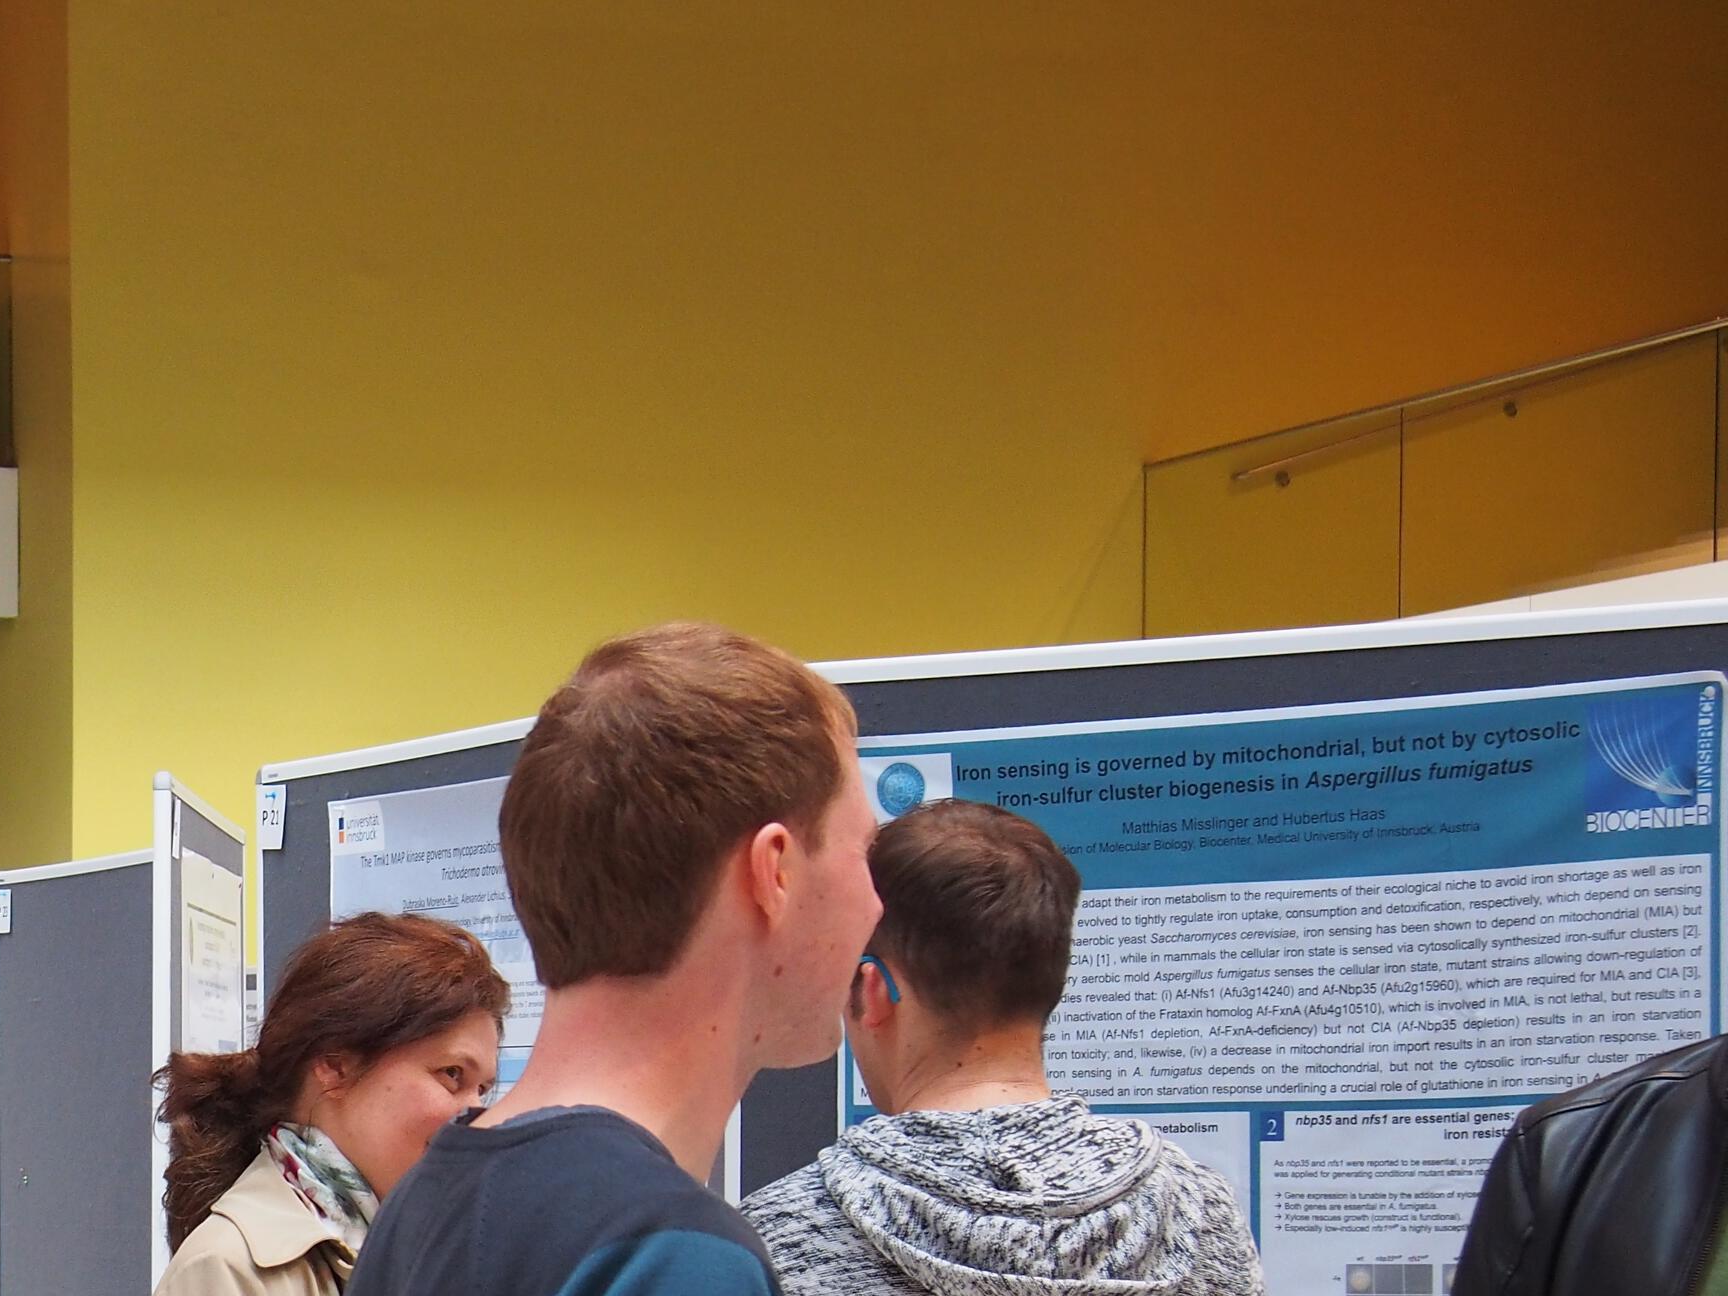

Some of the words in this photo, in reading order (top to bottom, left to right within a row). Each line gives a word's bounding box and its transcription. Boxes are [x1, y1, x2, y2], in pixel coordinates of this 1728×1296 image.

[956, 765, 991, 781] Iron
[994, 760, 1069, 779] sensing
[1075, 757, 1092, 773] is
[1095, 751, 1186, 776] governed
[1192, 749, 1216, 770] by
[1222, 739, 1365, 763] mitochondrial,
[1372, 736, 1406, 753] but
[1412, 733, 1445, 750] not
[1451, 730, 1476, 751] by
[1483, 721, 1580, 748] cytosolic
[994, 786, 1095, 810] iron-sulfur
[1098, 784, 1164, 801] cluster
[1168, 776, 1275, 799] biogenesis
[1281, 773, 1298, 790] in
[1304, 766, 1422, 789] Aspergillus
[1428, 759, 1533, 780] fumigatus
[262, 811, 269, 825] P
[270, 809, 279, 825] 21
[1122, 820, 1179, 836] Matthias
[1180, 816, 1251, 832] Misslinger
[1250, 813, 1278, 830] and
[1282, 811, 1346, 825] Hubertus
[1349, 808, 1386, 822] Haas
[1586, 804, 1710, 833] BIOCENTER
[1099, 841, 1151, 853] Molecular
[1082, 896, 1110, 908] adapt
[1114, 895, 1138, 906] their
[1140, 895, 1161, 905] iron
[1164, 892, 1227, 904] metabolism
[1229, 891, 1241, 901] to
[1243, 890, 1261, 900] the
[1264, 888, 1338, 901] requirements
[1340, 885, 1352, 896] of
[1354, 884, 1381, 895] their
[1383, 881, 1442, 895] ecological
[1444, 879, 1477, 890] niche
[1479, 879, 1492, 888] to
[1494, 874, 1528, 887] avoid
[1530, 873, 1554, 884] iron
[1557, 870, 1610, 882] shortage
[1612, 869, 1628, 878] as
[1630, 865, 1656, 877] well
[1659, 866, 1675, 875] as
[1678, 863, 1702, 874] iron
[1076, 915, 1118, 927] evolved
[1120, 915, 1133, 926] to
[1134, 913, 1167, 927] tightly
[1169, 911, 1214, 925] regulate
[1216, 910, 1238, 920] iron
[1240, 909, 1282, 921] uptake,
[1284, 905, 1357, 918] consumption
[1360, 903, 1384, 915] and
[1385, 900, 1465, 913] detoxification,
[1468, 894, 1542, 910] respectively,
[1546, 891, 1580, 902] which
[1583, 887, 1630, 901] depend
[1632, 888, 1650, 897] on
[1653, 884, 1702, 897] sensing
[1117, 934, 1147, 947] yeast
[1149, 931, 1237, 943] Saccharomyces
[1239, 928, 1299, 939] cerevisiae,
[1303, 927, 1324, 937] iron
[1328, 924, 1372, 937] sensing
[1375, 924, 1397, 934] has
[1400, 922, 1430, 933] been
[1433, 920, 1472, 931] shown
[1475, 919, 1488, 929] to
[1490, 914, 1536, 929] depend
[1538, 915, 1554, 924] on
[1558, 908, 1639, 922] mitochondrial
[1644, 905, 1679, 919] (MIA)
[1682, 904, 1702, 916] but
[1267, 1119, 1278, 1136] 2
[1295, 1115, 1332, 1128] nbp35
[1335, 1115, 1358, 1126] and
[1361, 1114, 1388, 1125] nfs1
[1391, 1116, 1411, 1125] are
[1415, 1112, 1470, 1124] essential
[1444, 1128, 1468, 1139] iron
[1472, 1127, 1507, 1139] resist
